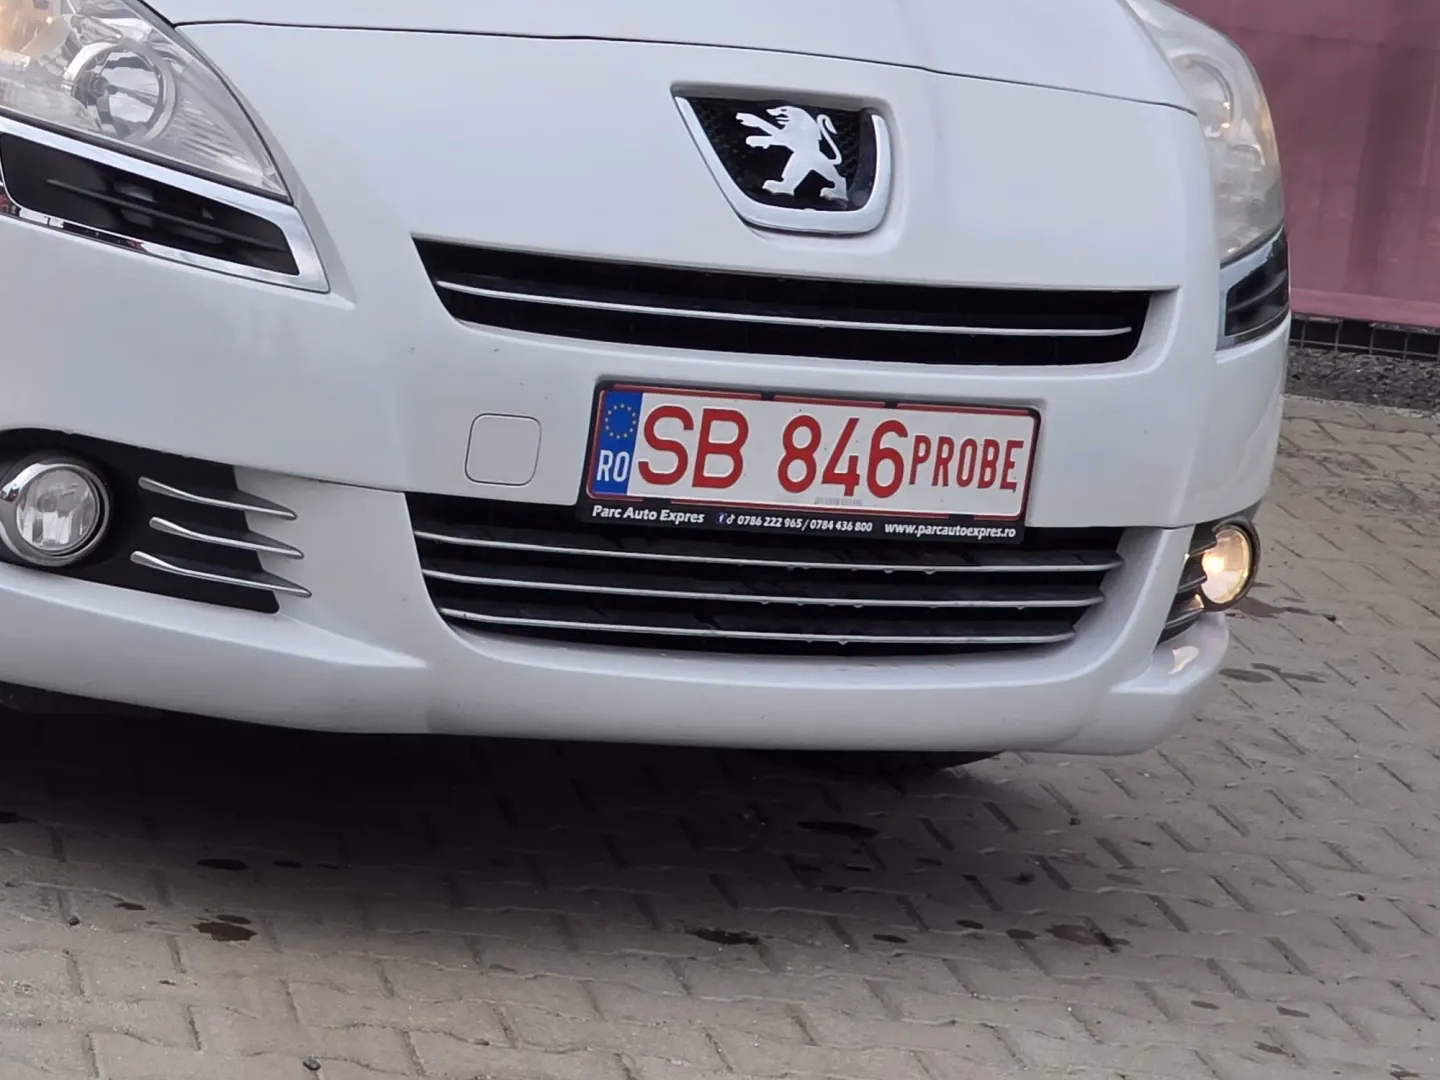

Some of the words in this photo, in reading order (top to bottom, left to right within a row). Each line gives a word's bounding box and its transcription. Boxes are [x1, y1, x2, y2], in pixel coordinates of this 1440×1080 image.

[597, 450, 631, 483] RO
[638, 405, 750, 489] SB
[777, 415, 909, 499] 846
[908, 433, 1025, 494] PROBE
[592, 504, 623, 518] Parc
[622, 506, 658, 521] Auto
[659, 508, 706, 526] Expres
[737, 514, 763, 526] 0786
[763, 516, 783, 528] 222
[809, 519, 835, 531] 0784
[835, 520, 854, 532] 436
[854, 521, 873, 533] 800
[884, 522, 1017, 540] www.parcautoexpres.ro
